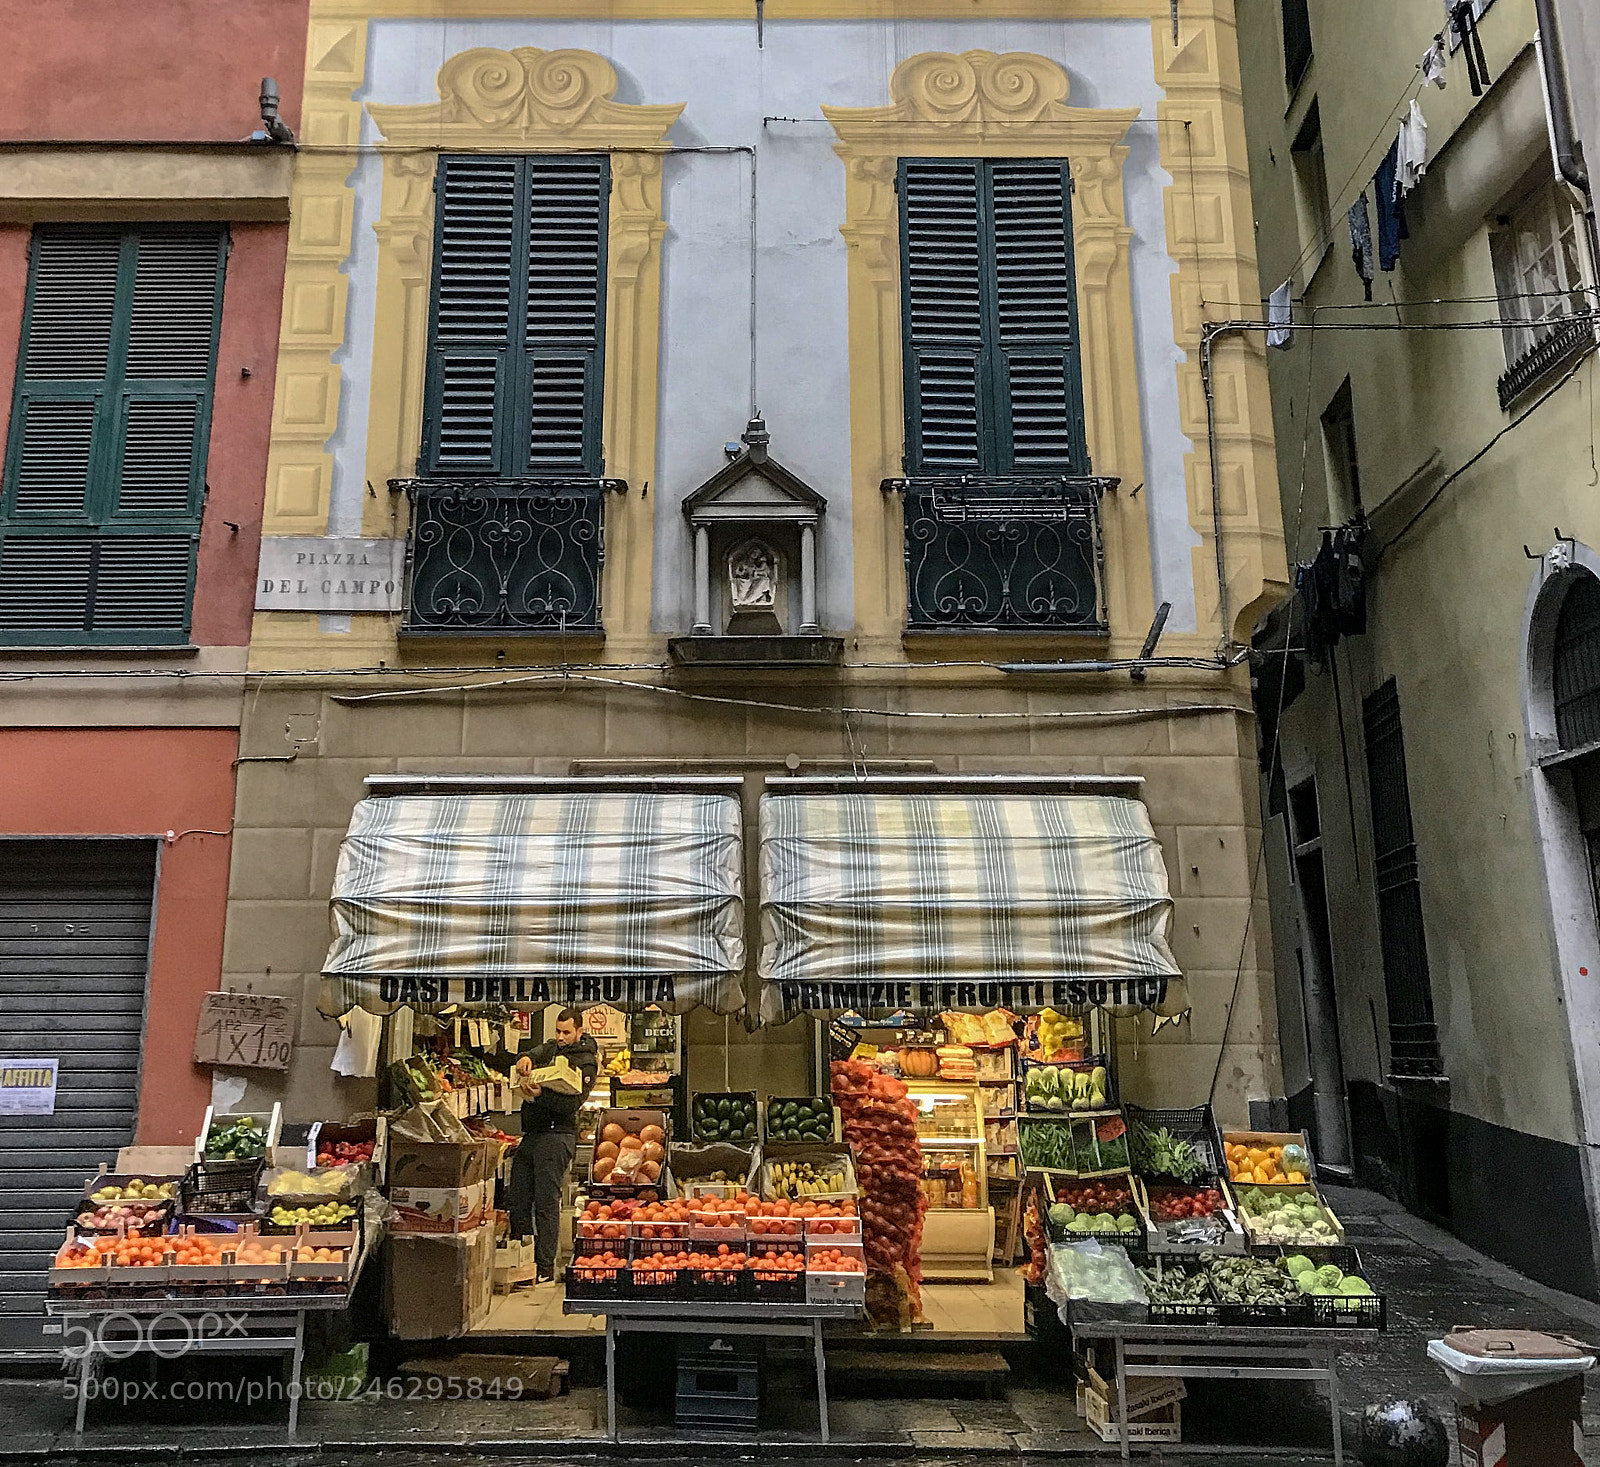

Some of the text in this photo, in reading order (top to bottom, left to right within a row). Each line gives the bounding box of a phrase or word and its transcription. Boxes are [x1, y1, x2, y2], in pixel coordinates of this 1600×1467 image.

[296, 552, 370, 566] PIAZZA
[261, 579, 395, 595] DEL CAMPO
[379, 976, 676, 1003] OASI DELLA FRUTTA
[782, 979, 1168, 1009] PRIMIZIE E FRUTTI ESOTICI
[2, 1068, 53, 1087] AFFITTA
